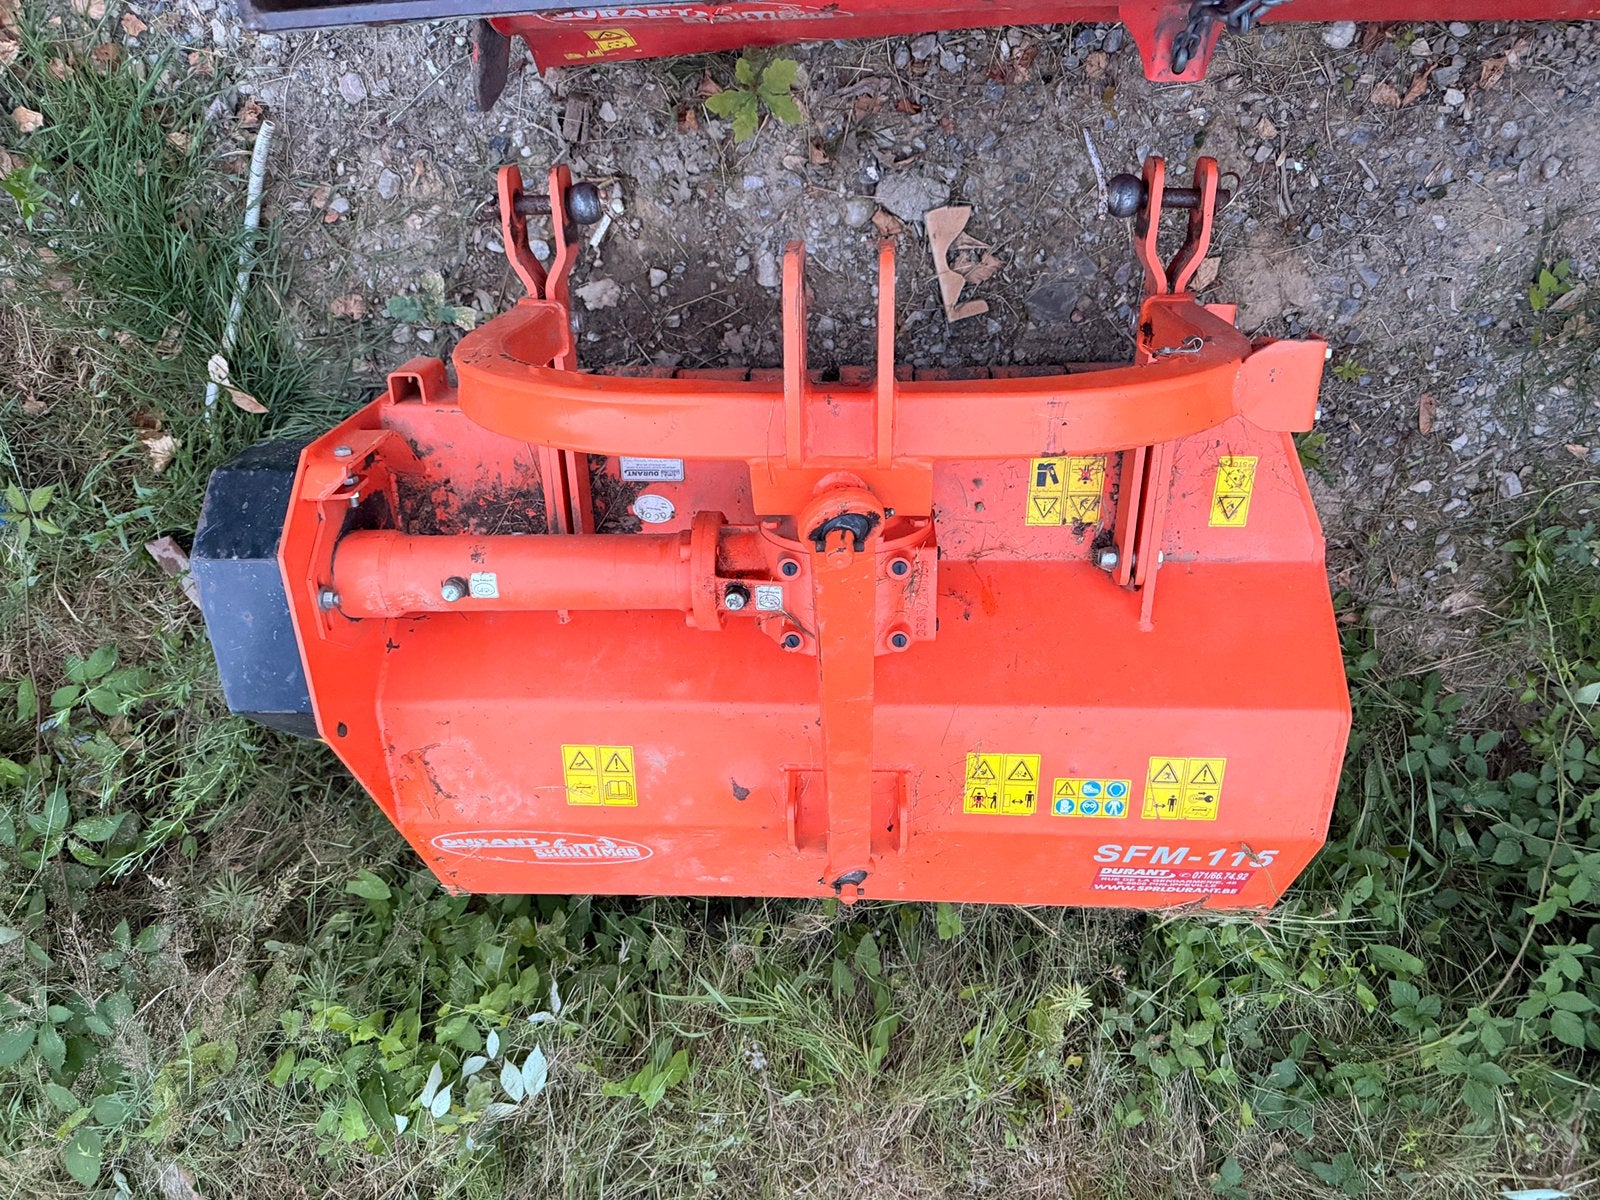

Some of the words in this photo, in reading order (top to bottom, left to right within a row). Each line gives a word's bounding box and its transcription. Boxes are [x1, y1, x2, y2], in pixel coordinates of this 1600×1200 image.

[627, 470, 659, 478] DURANT
[440, 838, 538, 847] DURANT
[533, 842, 641, 858] SHAKTIMAN
[1093, 844, 1280, 869] SFM-115
[1100, 867, 1171, 877] DURANT
[1191, 871, 1250, 882] 071/66.74.92
[1094, 884, 1239, 895] WWW.SPRLDURANT.BE
